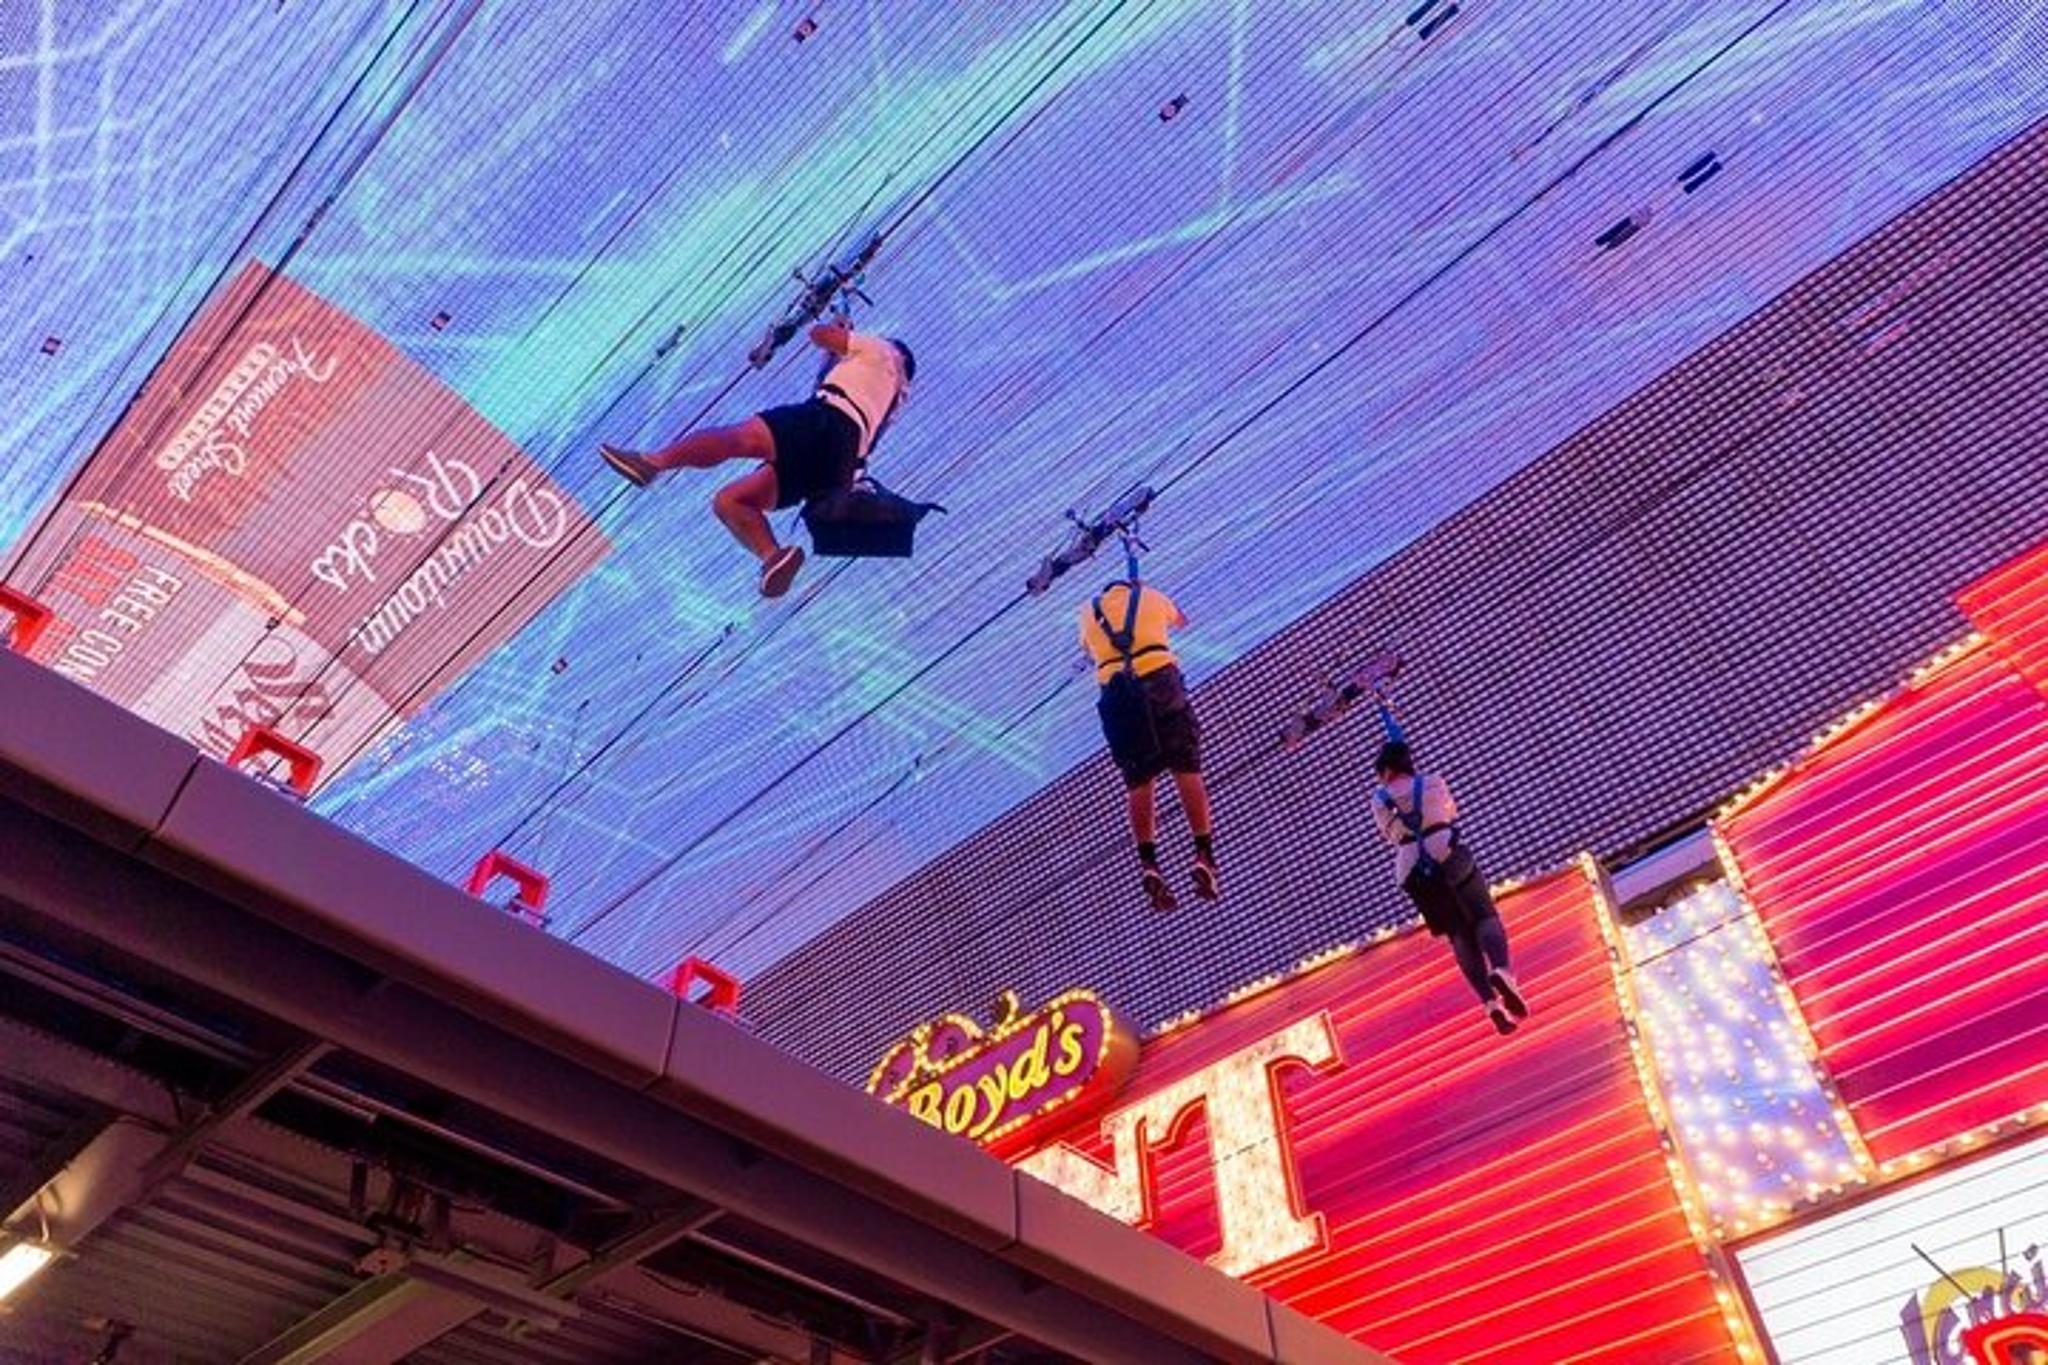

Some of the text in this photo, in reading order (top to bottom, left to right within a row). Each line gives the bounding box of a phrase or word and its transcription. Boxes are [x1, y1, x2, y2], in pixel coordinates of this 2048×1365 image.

[167, 335, 338, 503] Fremont Street
[311, 450, 484, 593] Rocks
[350, 477, 567, 655] Downtown
[99, 564, 183, 633] FREE
[908, 1010, 1084, 1140] Boyd's
